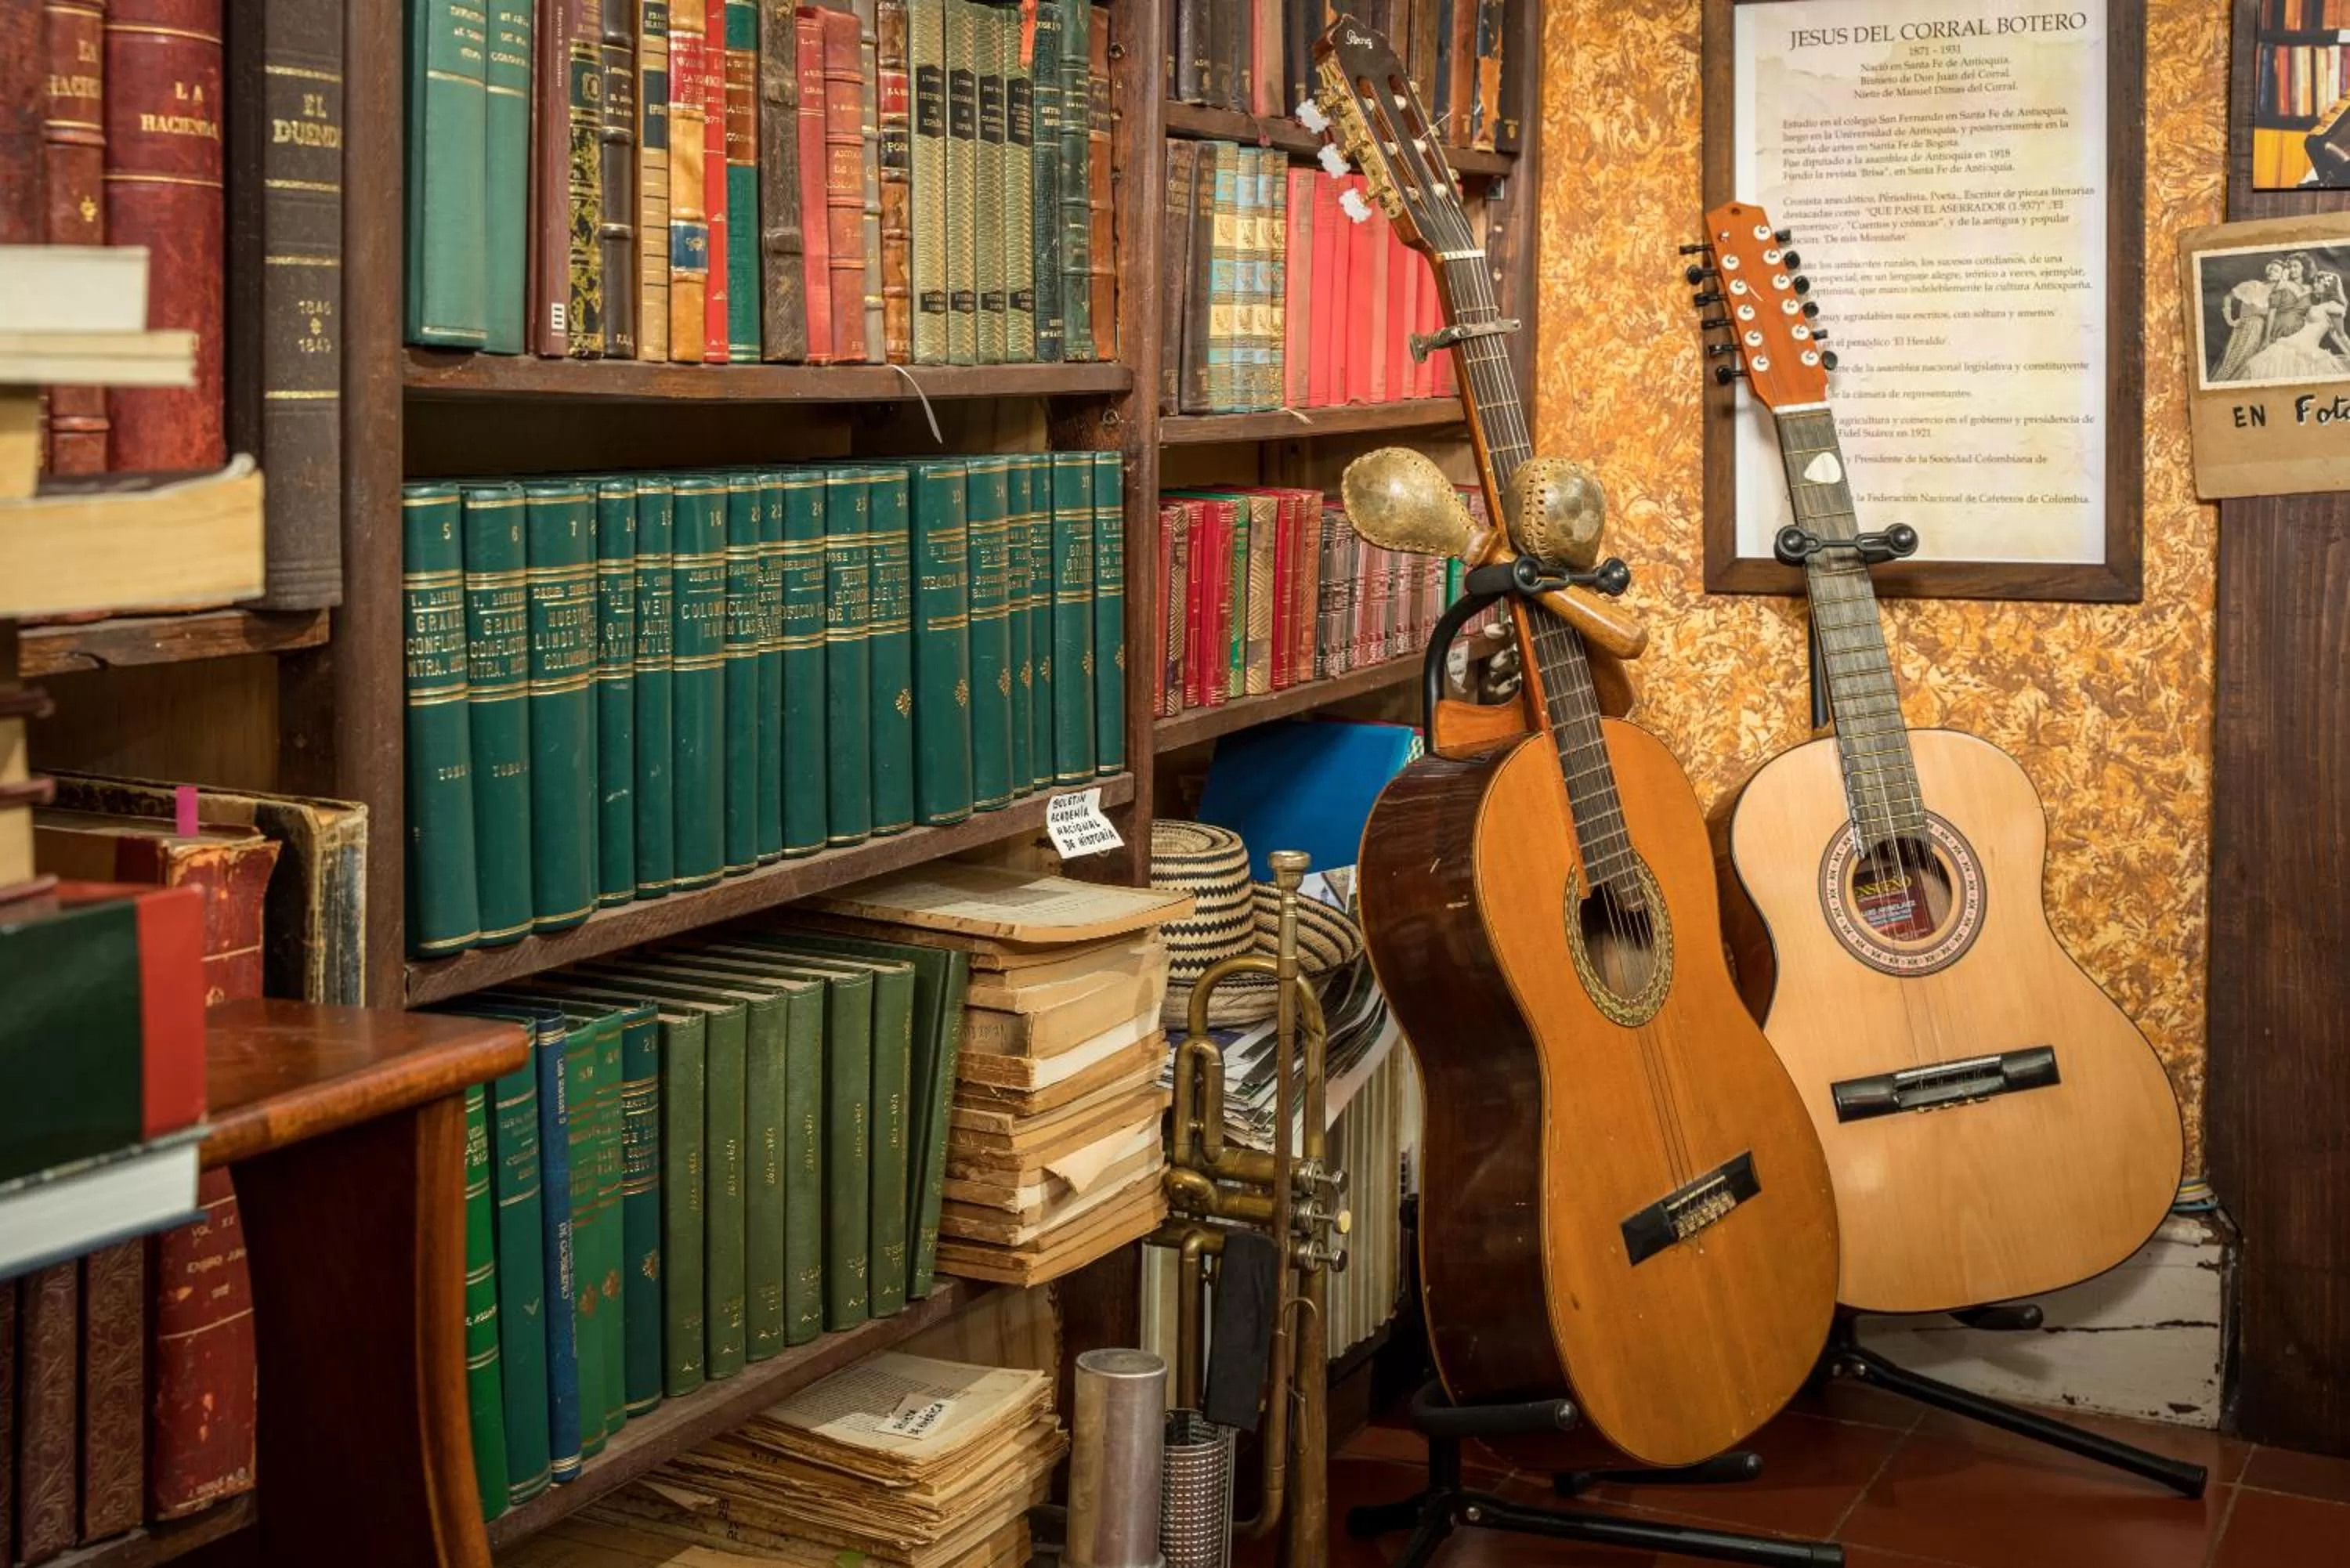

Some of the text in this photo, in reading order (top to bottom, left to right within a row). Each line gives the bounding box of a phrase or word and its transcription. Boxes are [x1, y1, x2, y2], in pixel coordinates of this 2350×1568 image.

[1789, 13, 2087, 50] JESUS DEL CORRAL BOTERO
[1940, 44, 1961, 54] 1931
[1904, 60, 1929, 69] Santa
[1932, 59, 1943, 67] Fe
[1945, 58, 1958, 67] de
[1914, 73, 1934, 81] Don
[1936, 71, 1958, 83] Juan
[1961, 70, 1975, 79] del
[1882, 89, 1893, 97] de
[1896, 86, 1932, 96] Manuel
[1968, 82, 1982, 92] del
[1985, 81, 2018, 92] Corral.
[302, 93, 327, 117] EL
[1834, 117, 1842, 126] el
[1959, 110, 1985, 120] Santa
[1989, 109, 1999, 118] Fe
[2002, 108, 2013, 117] de
[2233, 404, 2265, 428] EN
[443, 522, 451, 540] 5
